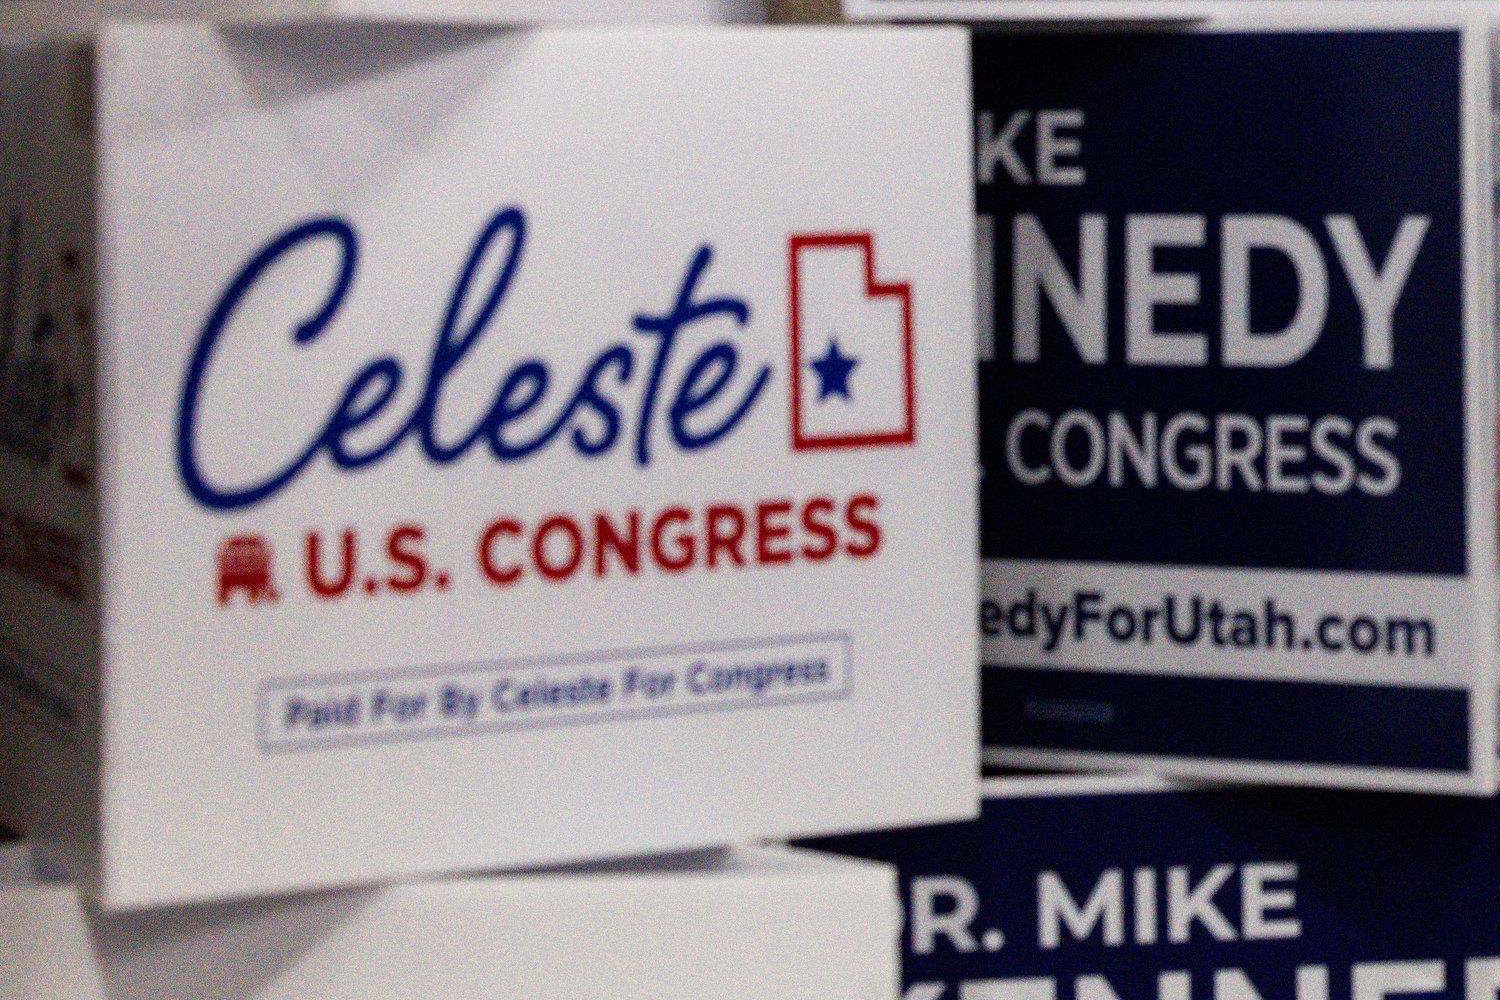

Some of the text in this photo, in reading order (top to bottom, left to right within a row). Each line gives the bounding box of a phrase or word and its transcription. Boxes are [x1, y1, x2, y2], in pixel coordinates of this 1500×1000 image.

[976, 108, 1087, 186] KE
[976, 213, 1431, 370] NEDY
[176, 205, 772, 511] Celeste
[1006, 409, 1402, 496] CONGRESS
[306, 493, 884, 599] U.S. CONGRESS
[980, 590, 1437, 657] edyForUtah.com
[284, 656, 829, 731] Paid For By Celeste For Congress
[901, 862, 1303, 954] R. MIKE
